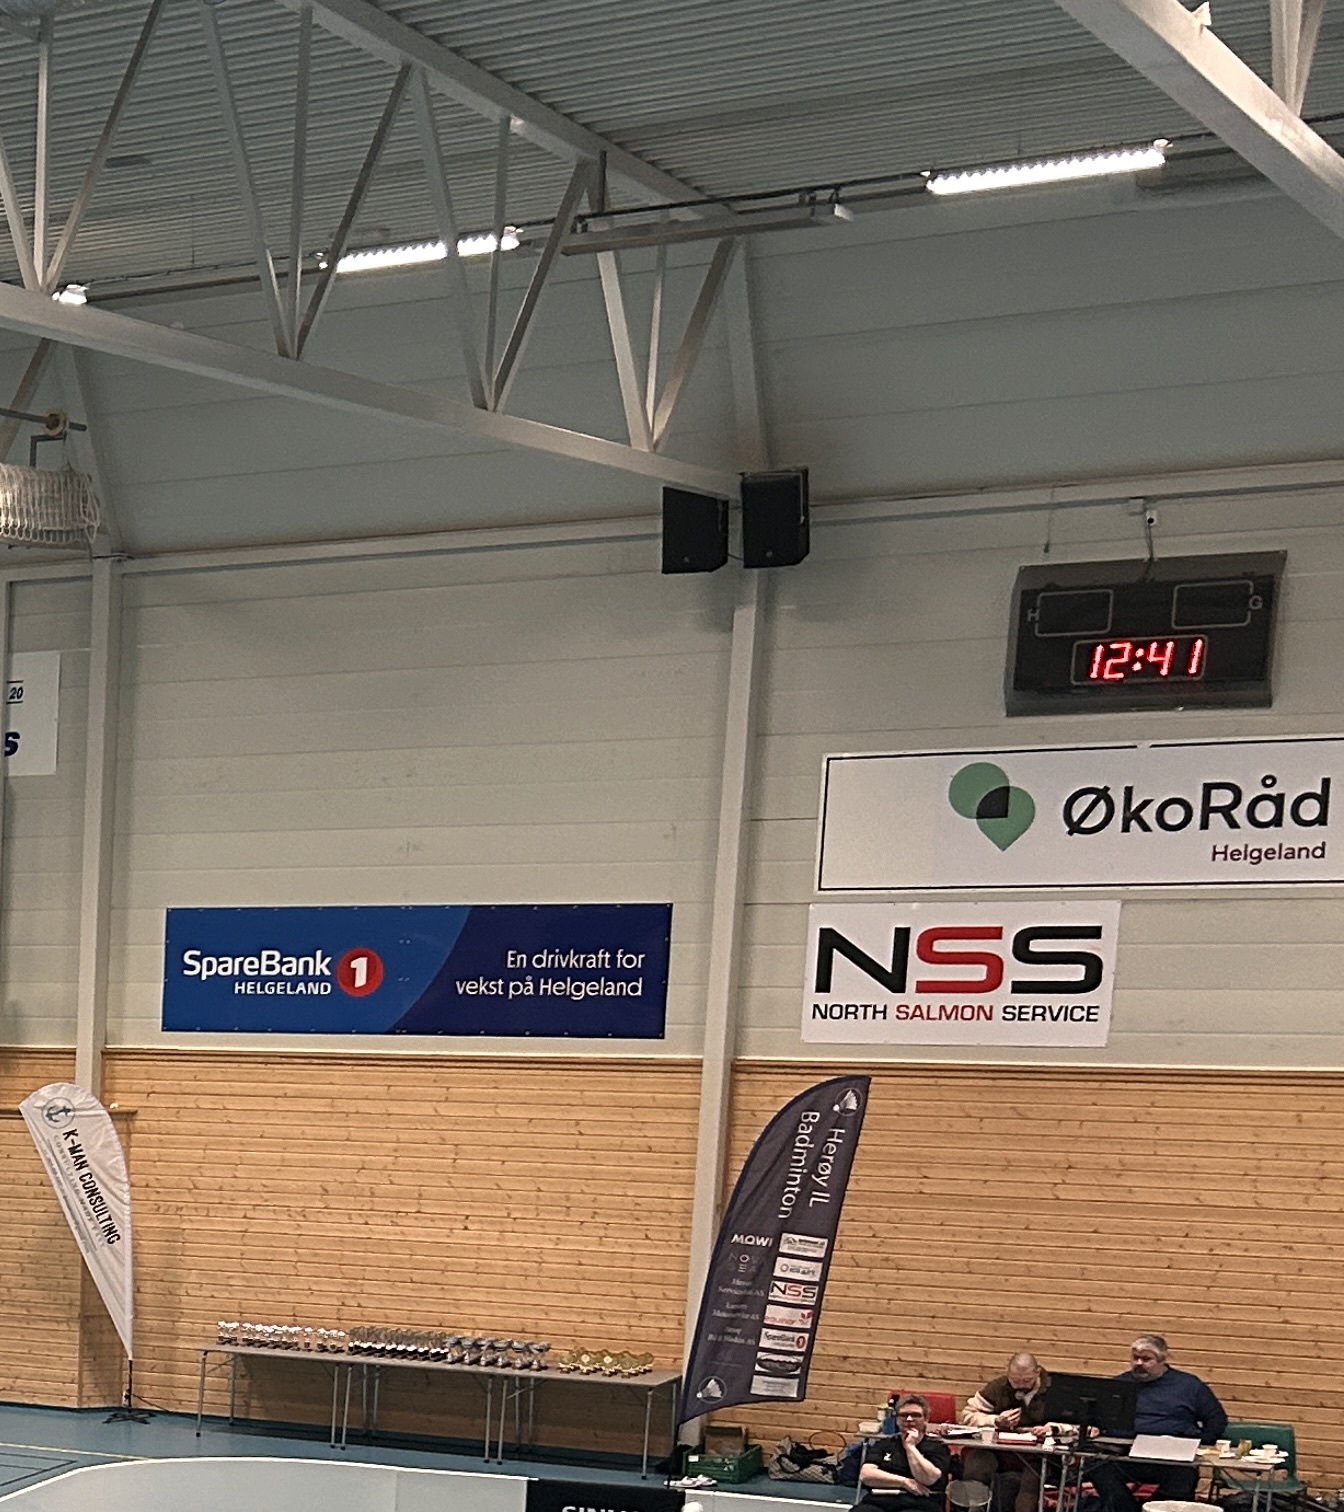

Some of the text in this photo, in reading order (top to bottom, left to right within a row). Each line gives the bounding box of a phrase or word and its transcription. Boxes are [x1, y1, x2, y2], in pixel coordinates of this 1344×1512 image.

[1089, 639, 1203, 679] 12:41
[9, 686, 24, 700] 20
[1063, 775, 1331, 836] ØkoRåd
[1212, 841, 1327, 865] Helgeland
[183, 949, 368, 988] SpareBank 1
[507, 948, 645, 968] En drivkraft for
[814, 925, 1103, 994] NSS
[234, 981, 332, 995] HELGELAND
[456, 976, 643, 1000] vekst på Helgeland
[812, 1004, 1100, 1023] NORTH SALMON SERVICE
[777, 1111, 821, 1219] Badminton
[808, 1128, 846, 1208] Herøy IL
[63, 1128, 89, 1171] K-MAN
[79, 1172, 121, 1245] CONSULTING
[771, 1282, 818, 1300] NSS
